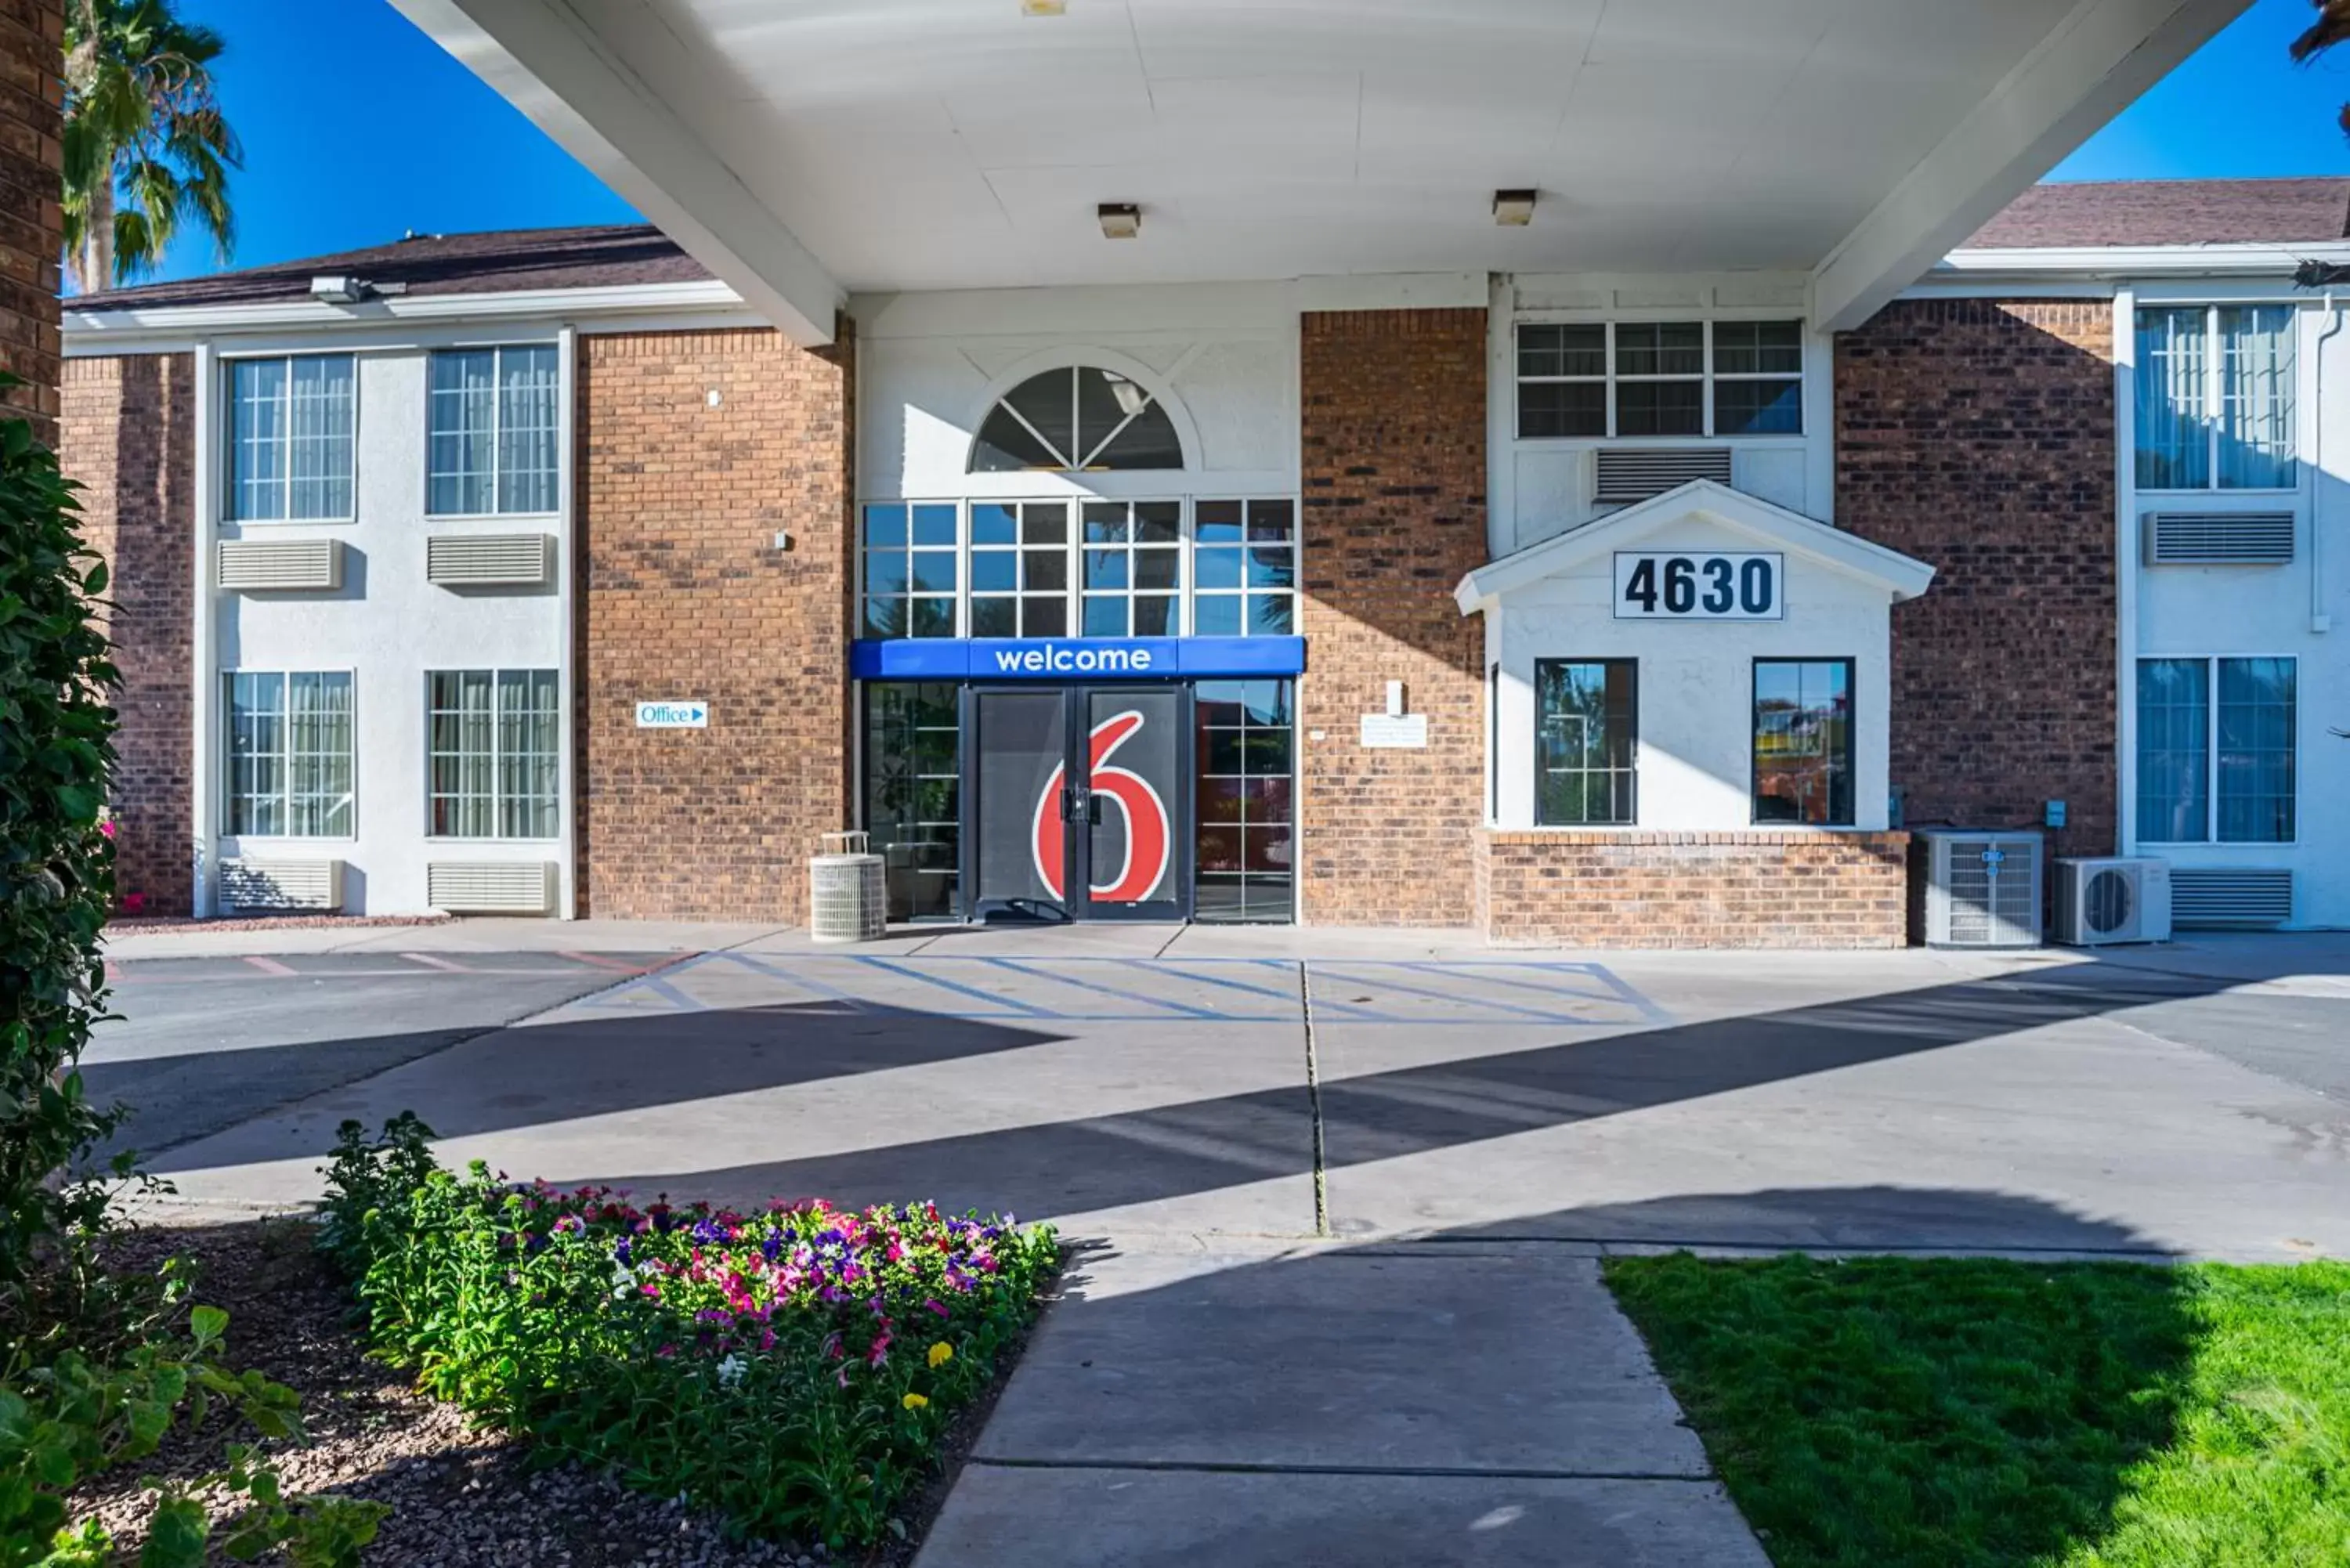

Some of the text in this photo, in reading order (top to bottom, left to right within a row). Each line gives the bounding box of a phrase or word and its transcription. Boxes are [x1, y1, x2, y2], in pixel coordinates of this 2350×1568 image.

[1625, 557, 1772, 614] 4630
[996, 644, 1152, 671] welcome
[642, 706, 689, 723] Office
[1032, 710, 1170, 902] 6
